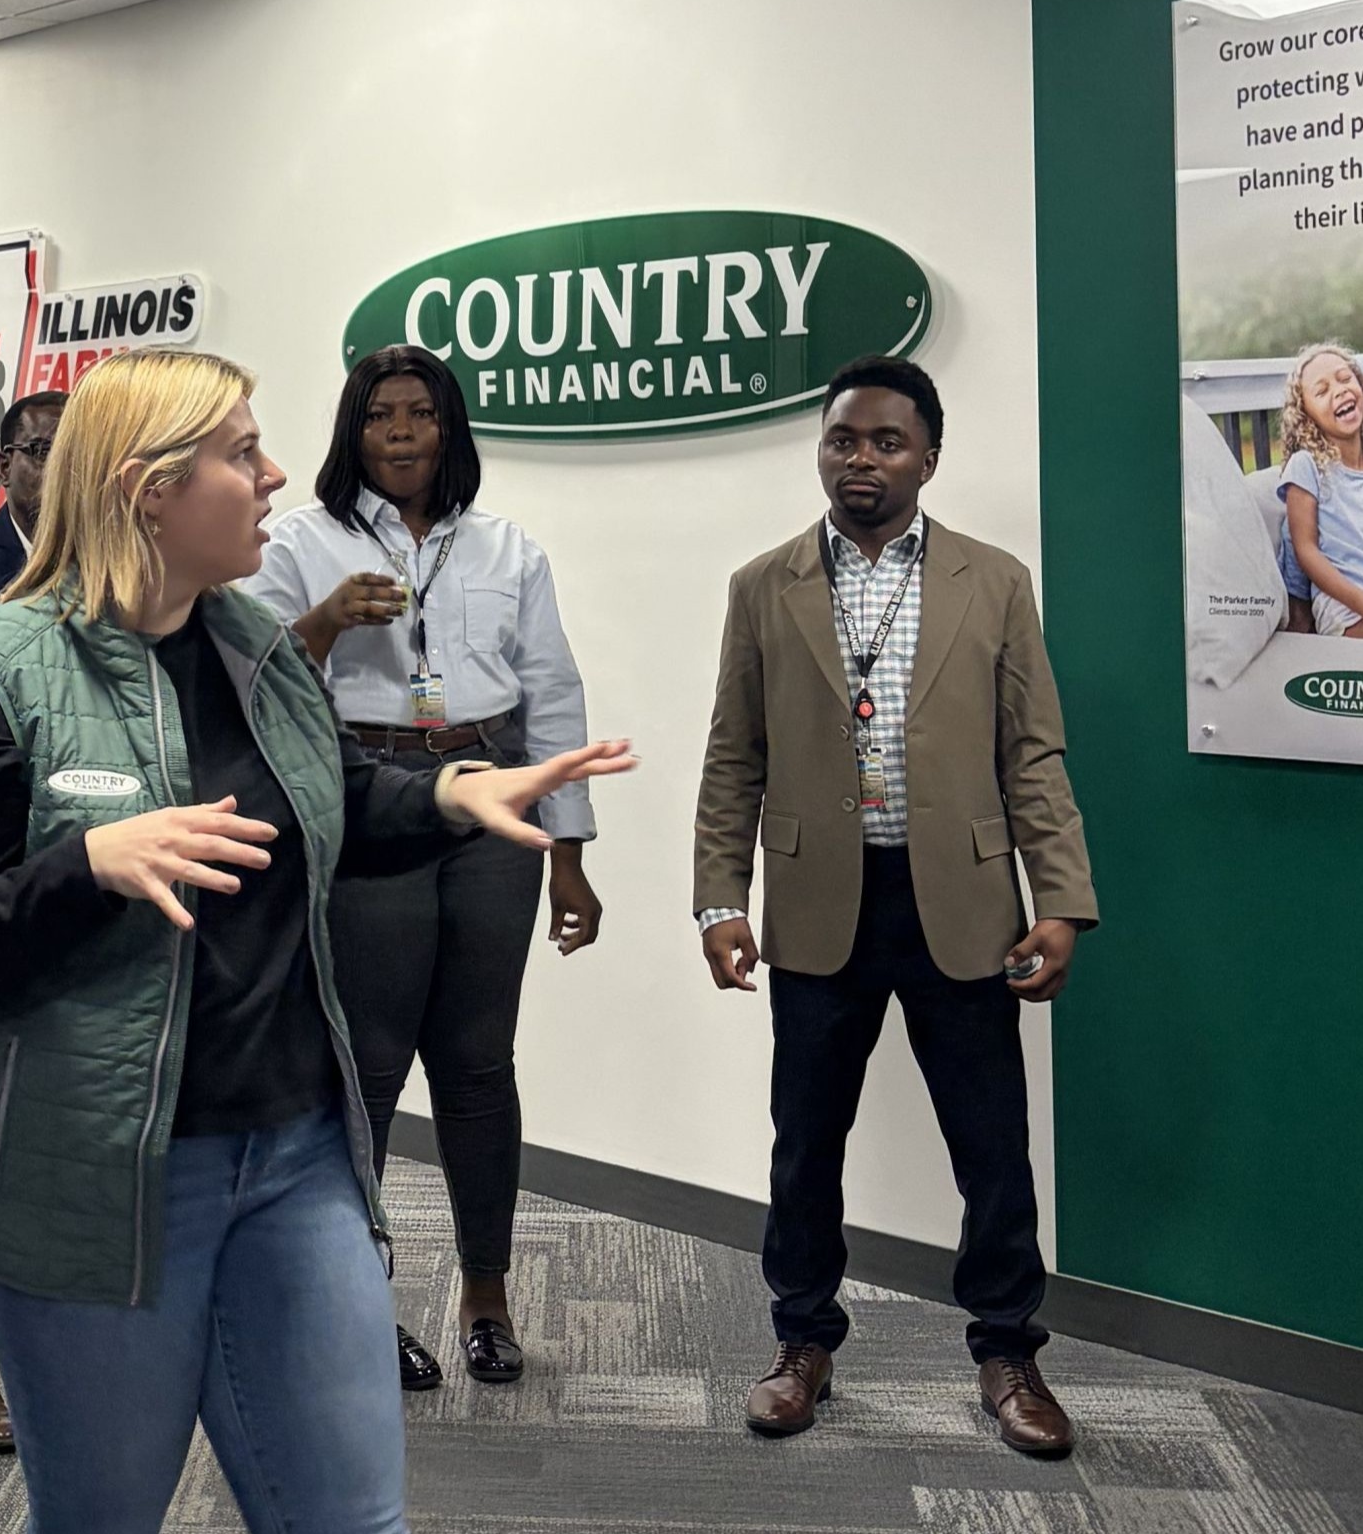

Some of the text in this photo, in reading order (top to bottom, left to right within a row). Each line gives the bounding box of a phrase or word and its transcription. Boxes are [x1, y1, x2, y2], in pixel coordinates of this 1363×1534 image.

[1219, 38, 1274, 62] Grow
[1280, 31, 1318, 53] our
[1236, 70, 1349, 109] protecting
[1246, 124, 1297, 147] have
[1303, 113, 1344, 139] and
[1239, 162, 1334, 197] planning
[1294, 205, 1347, 230] their
[38, 284, 196, 345] ILLINOIS
[405, 242, 830, 362] COUNTRY
[30, 346, 130, 394] FAR
[1209, 595, 1276, 607] The Parker Family
[1209, 608, 1231, 616] Clients
[62, 774, 126, 786] COUNTRY
